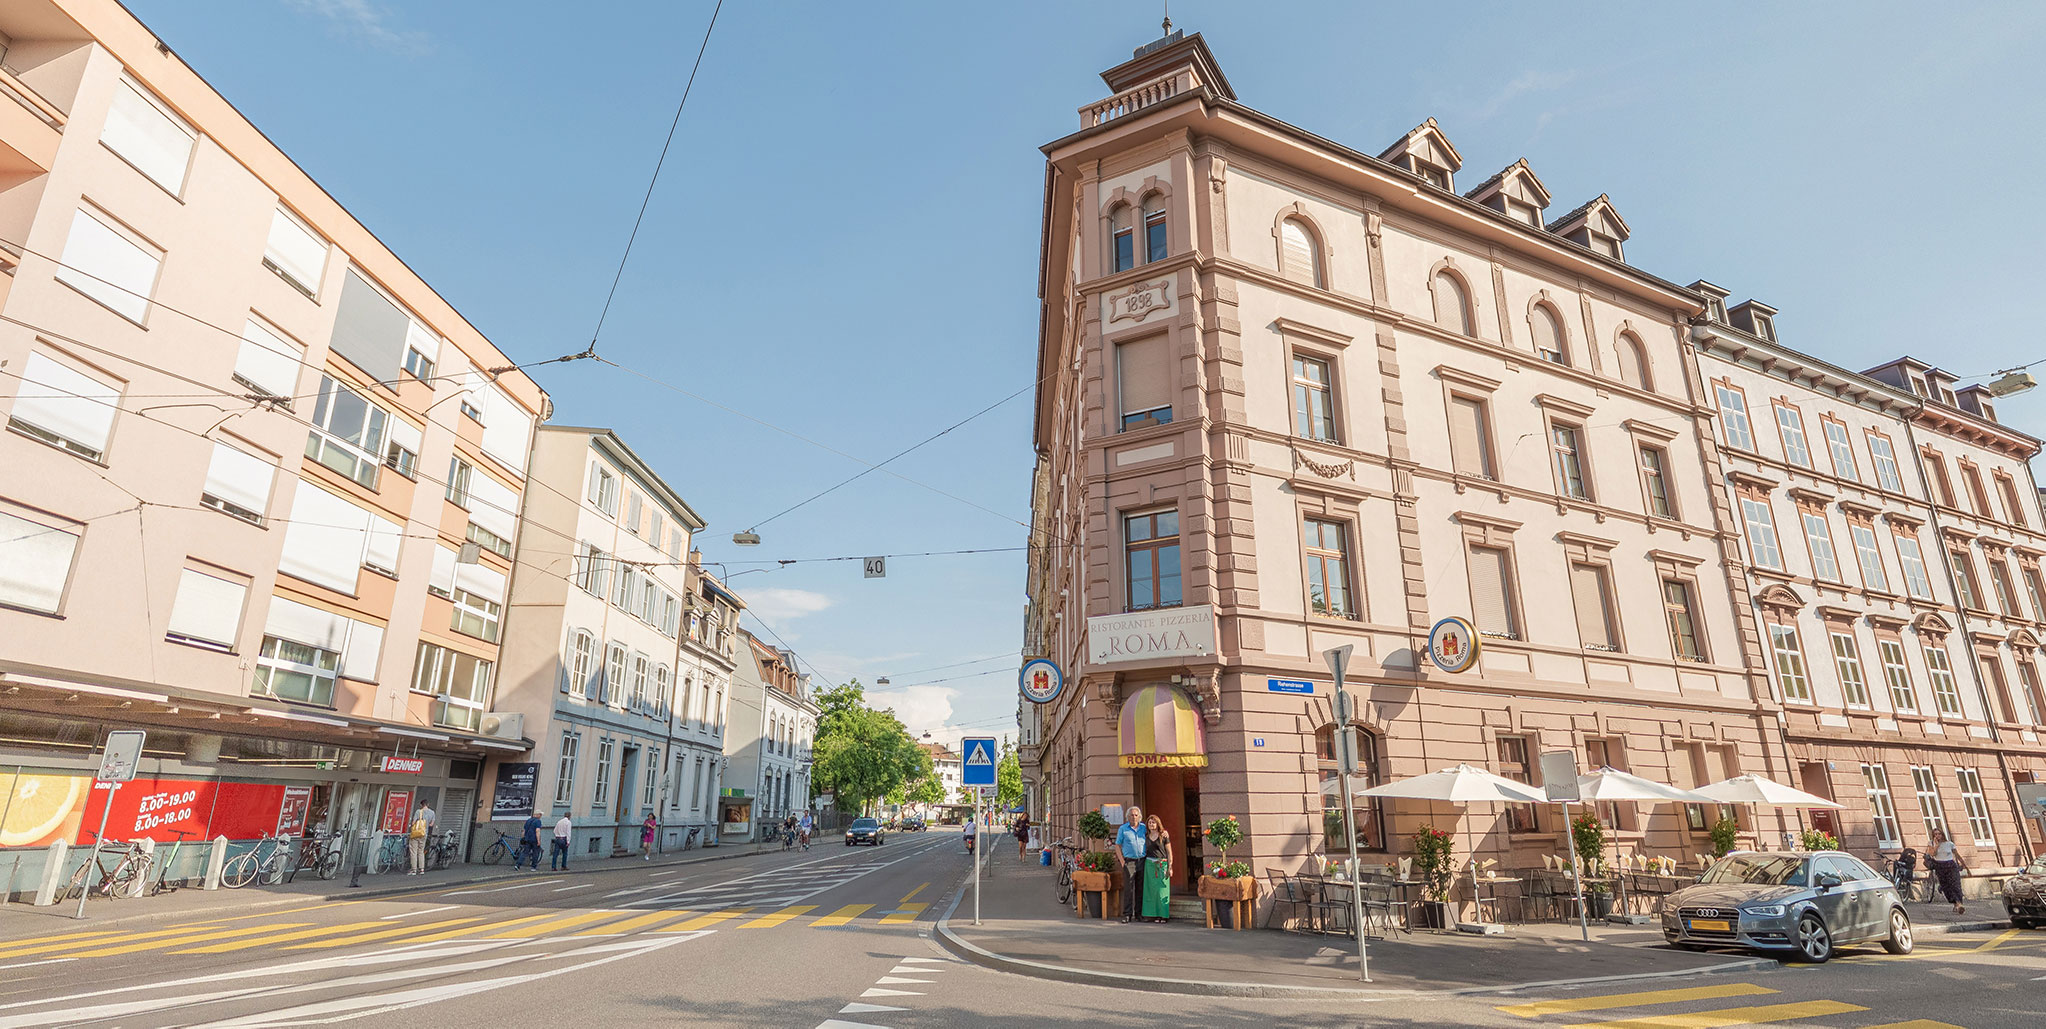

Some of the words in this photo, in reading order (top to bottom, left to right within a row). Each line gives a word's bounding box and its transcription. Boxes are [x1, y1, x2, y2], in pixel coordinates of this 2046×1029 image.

[1125, 293, 1152, 312] 1898
[867, 560, 883, 574] 40
[1091, 618, 1155, 633] RISTORANTE
[1160, 613, 1210, 627] PIZZERIA
[1109, 630, 1193, 655] ROMA
[1435, 646, 1454, 665] Pizzeria
[1455, 642, 1467, 662] Roma
[1026, 681, 1044, 697] Pizzeria
[1044, 681, 1057, 696] Roma
[387, 759, 423, 772] DENNER
[1127, 754, 1168, 765] ROMA
[94, 782, 123, 790] DENER
[139, 790, 196, 813] 8.00-19.00
[134, 808, 192, 832] 8.00-18.00
